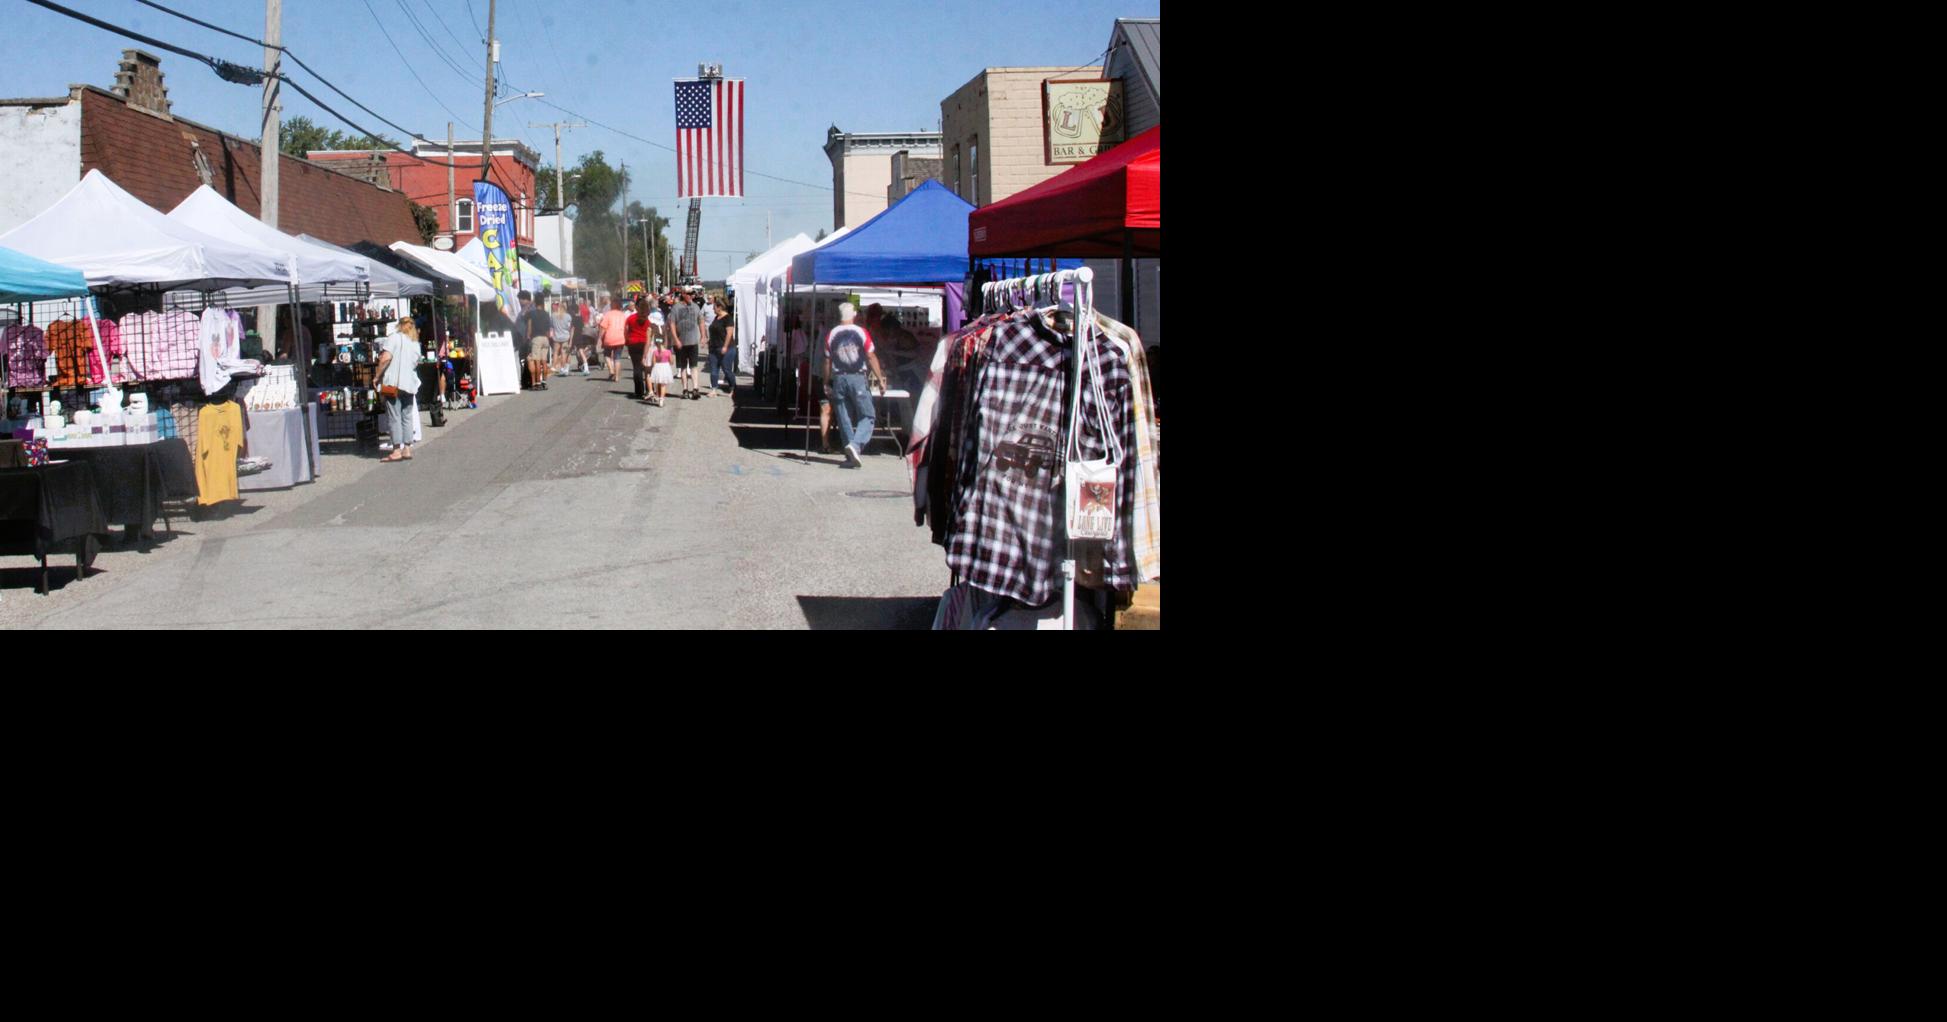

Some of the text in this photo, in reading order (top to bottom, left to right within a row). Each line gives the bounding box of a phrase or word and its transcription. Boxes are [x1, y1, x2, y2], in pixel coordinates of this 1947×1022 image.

[1053, 146, 1074, 156] BAR
[1078, 146, 1085, 155] &
[477, 202, 507, 212] Freeze
[480, 215, 506, 225] Dried
